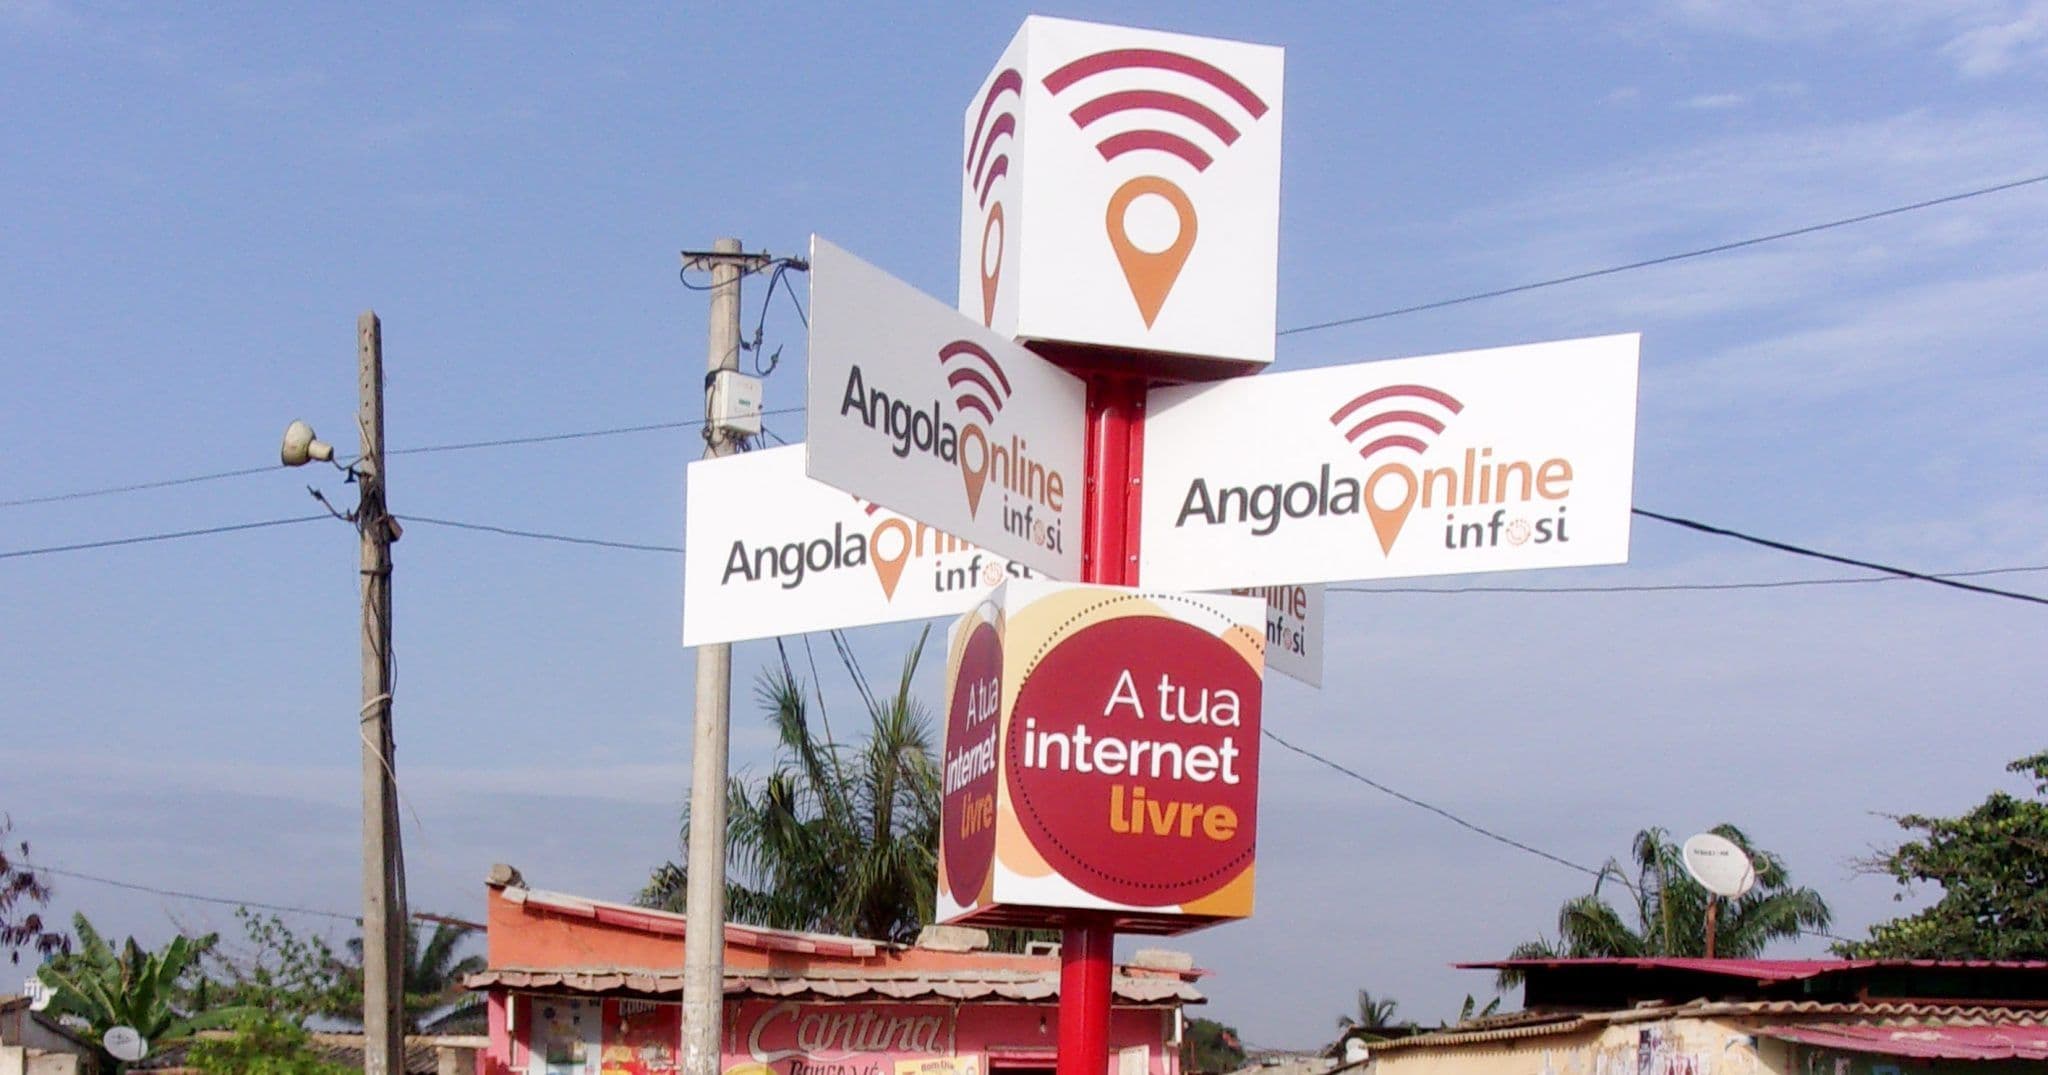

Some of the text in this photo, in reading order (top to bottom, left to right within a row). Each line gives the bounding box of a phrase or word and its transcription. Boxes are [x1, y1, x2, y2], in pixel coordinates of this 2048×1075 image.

[966, 677, 999, 733] A tua
[1103, 669, 1240, 727] A tua
[945, 723, 997, 797] internet
[1023, 717, 1240, 785] internet
[960, 791, 994, 841] livre
[1109, 784, 1239, 841] livre
